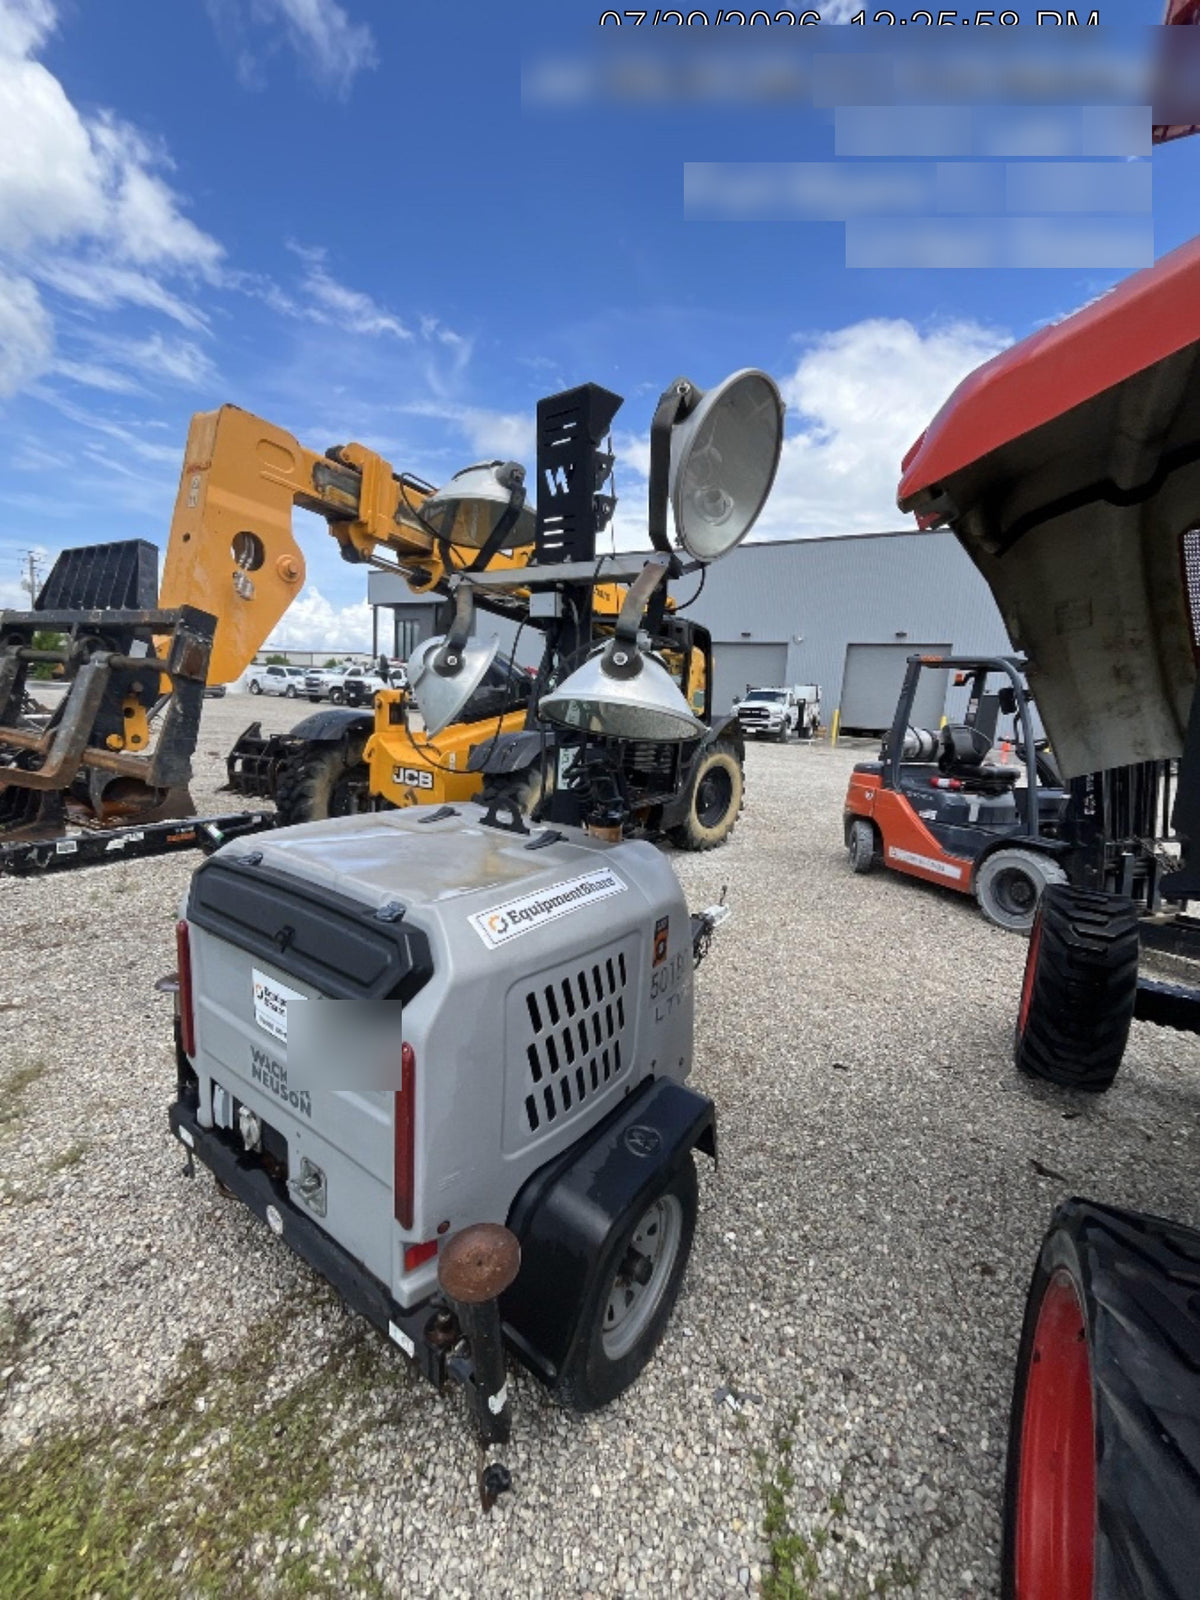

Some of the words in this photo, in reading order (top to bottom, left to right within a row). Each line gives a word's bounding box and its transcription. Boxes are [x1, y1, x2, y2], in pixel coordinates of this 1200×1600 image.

[393, 767, 433, 789] JCB
[506, 876, 616, 925] EquipmentShare
[251, 1062, 312, 1119] NEUSON
